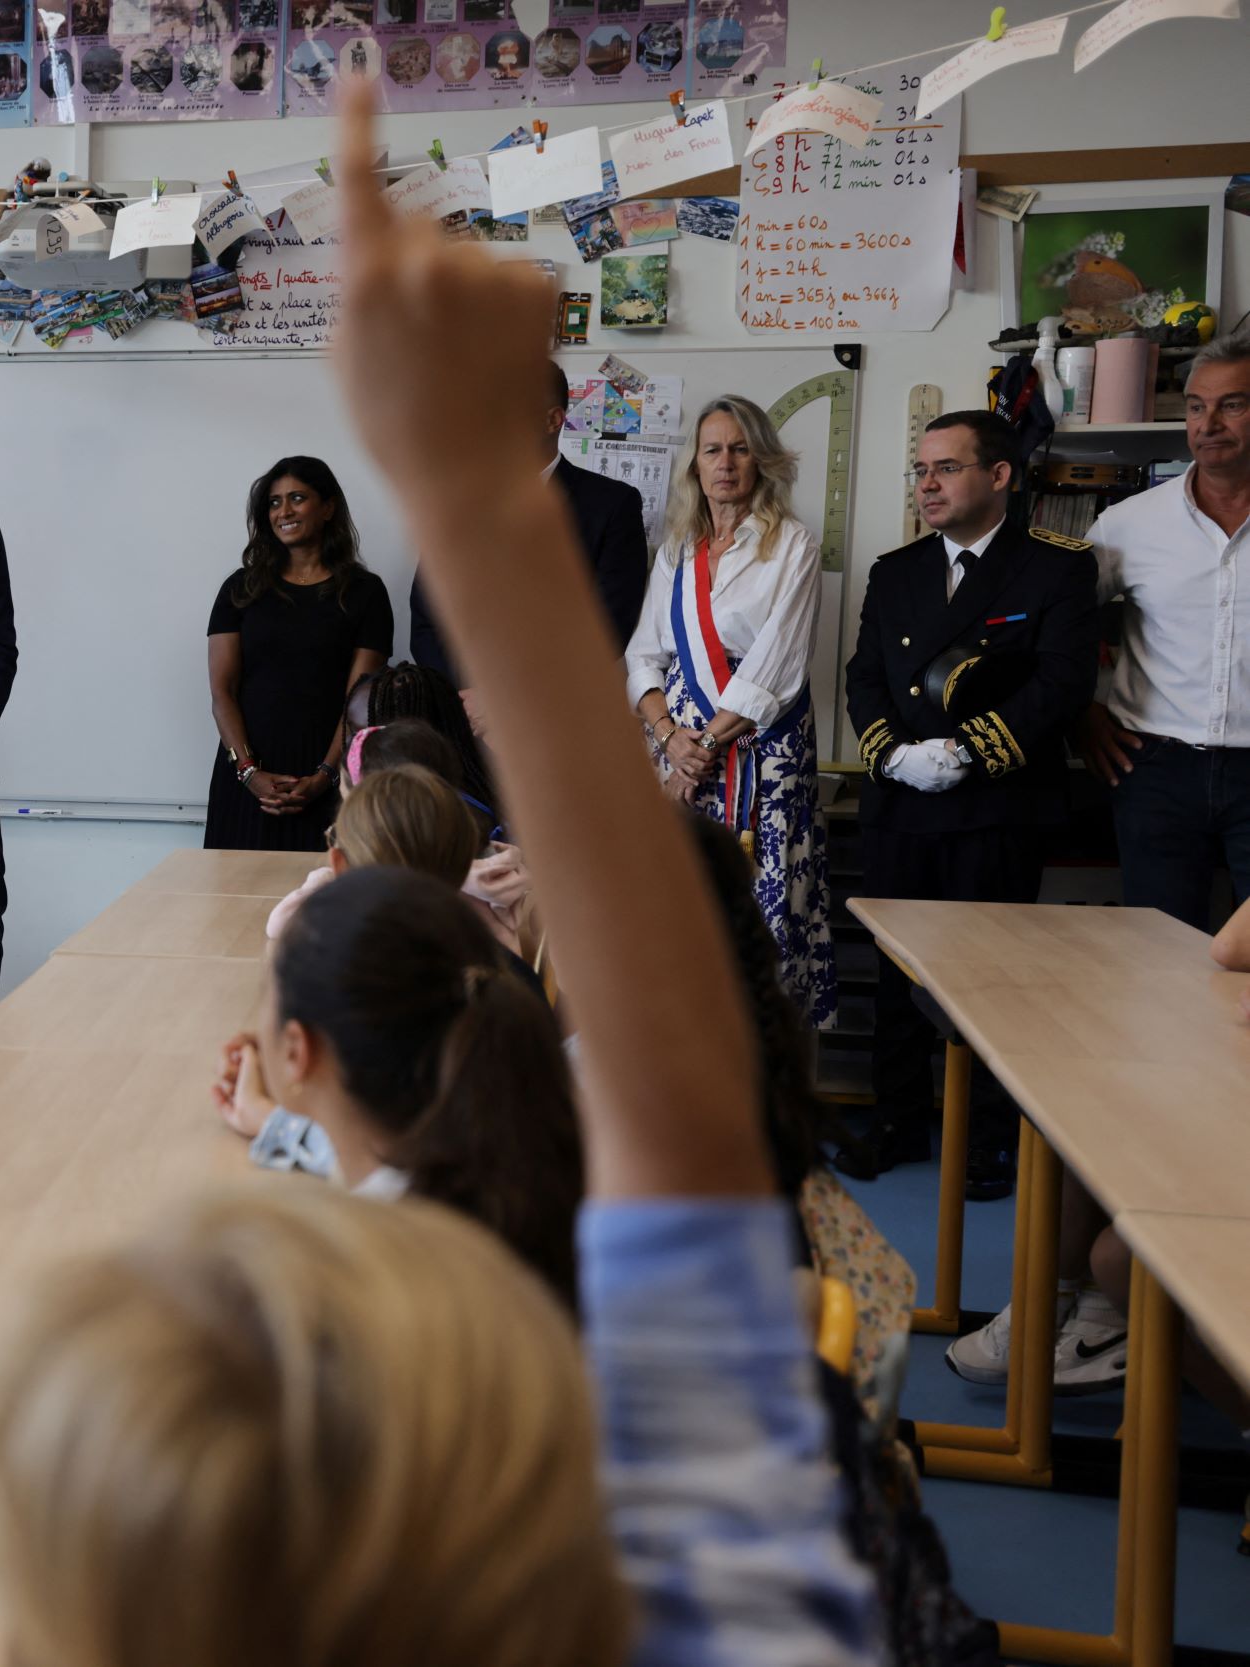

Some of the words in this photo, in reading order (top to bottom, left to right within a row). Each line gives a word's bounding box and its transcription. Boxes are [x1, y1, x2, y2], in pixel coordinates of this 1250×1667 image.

[899, 74, 921, 91] 30
[683, 106, 715, 128] Capet
[775, 134, 785, 151] 8
[795, 134, 812, 152] h
[895, 128, 918, 144] 61
[775, 154, 785, 173] 8
[794, 152, 811, 173] h
[821, 154, 843, 171] 72
[850, 156, 882, 168] min
[772, 177, 783, 195] 9
[792, 173, 810, 194] h
[820, 173, 842, 190] 12
[848, 176, 883, 189] min
[741, 215, 751, 232] 1
[755, 219, 781, 231] min
[740, 236, 750, 250] 1
[756, 236, 767, 251] h
[809, 239, 836, 250] min
[740, 260, 750, 276] 1
[741, 283, 751, 299] 1
[755, 291, 778, 302] an
[279, 290, 313, 318] place
[272, 313, 290, 330] les
[809, 315, 834, 329] 100
